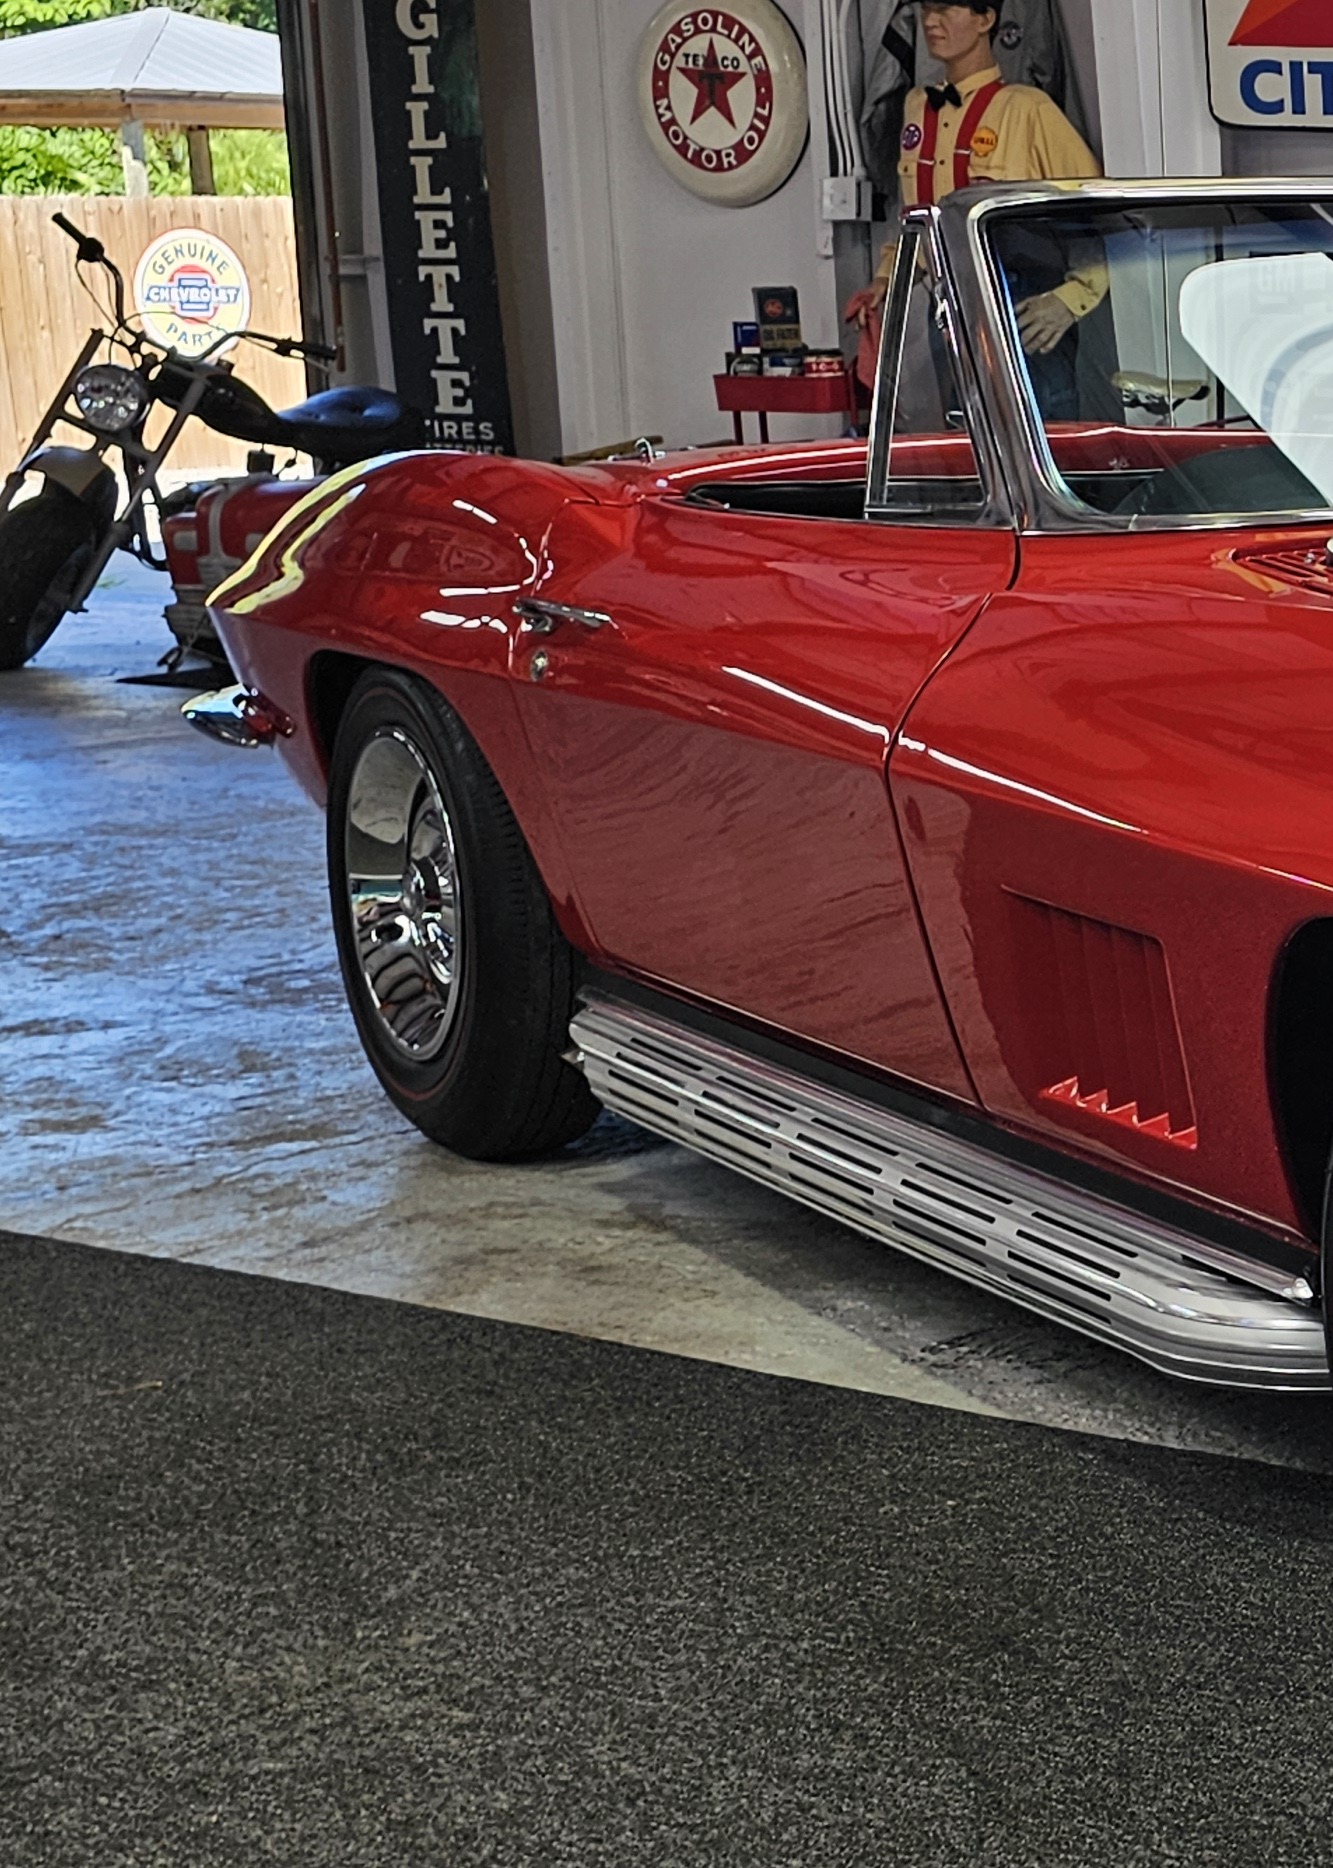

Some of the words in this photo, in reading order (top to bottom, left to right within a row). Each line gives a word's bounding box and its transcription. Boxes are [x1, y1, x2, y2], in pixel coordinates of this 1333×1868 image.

[657, 12, 766, 75] GASOLINE
[656, 97, 738, 169] MOTOR
[743, 101, 770, 150] OIL
[395, 0, 473, 415] GILLETTE
[152, 242, 230, 276] GENUINE
[148, 286, 239, 304] CHEVROLET
[166, 321, 226, 347] PART
[424, 419, 495, 440] IRES
